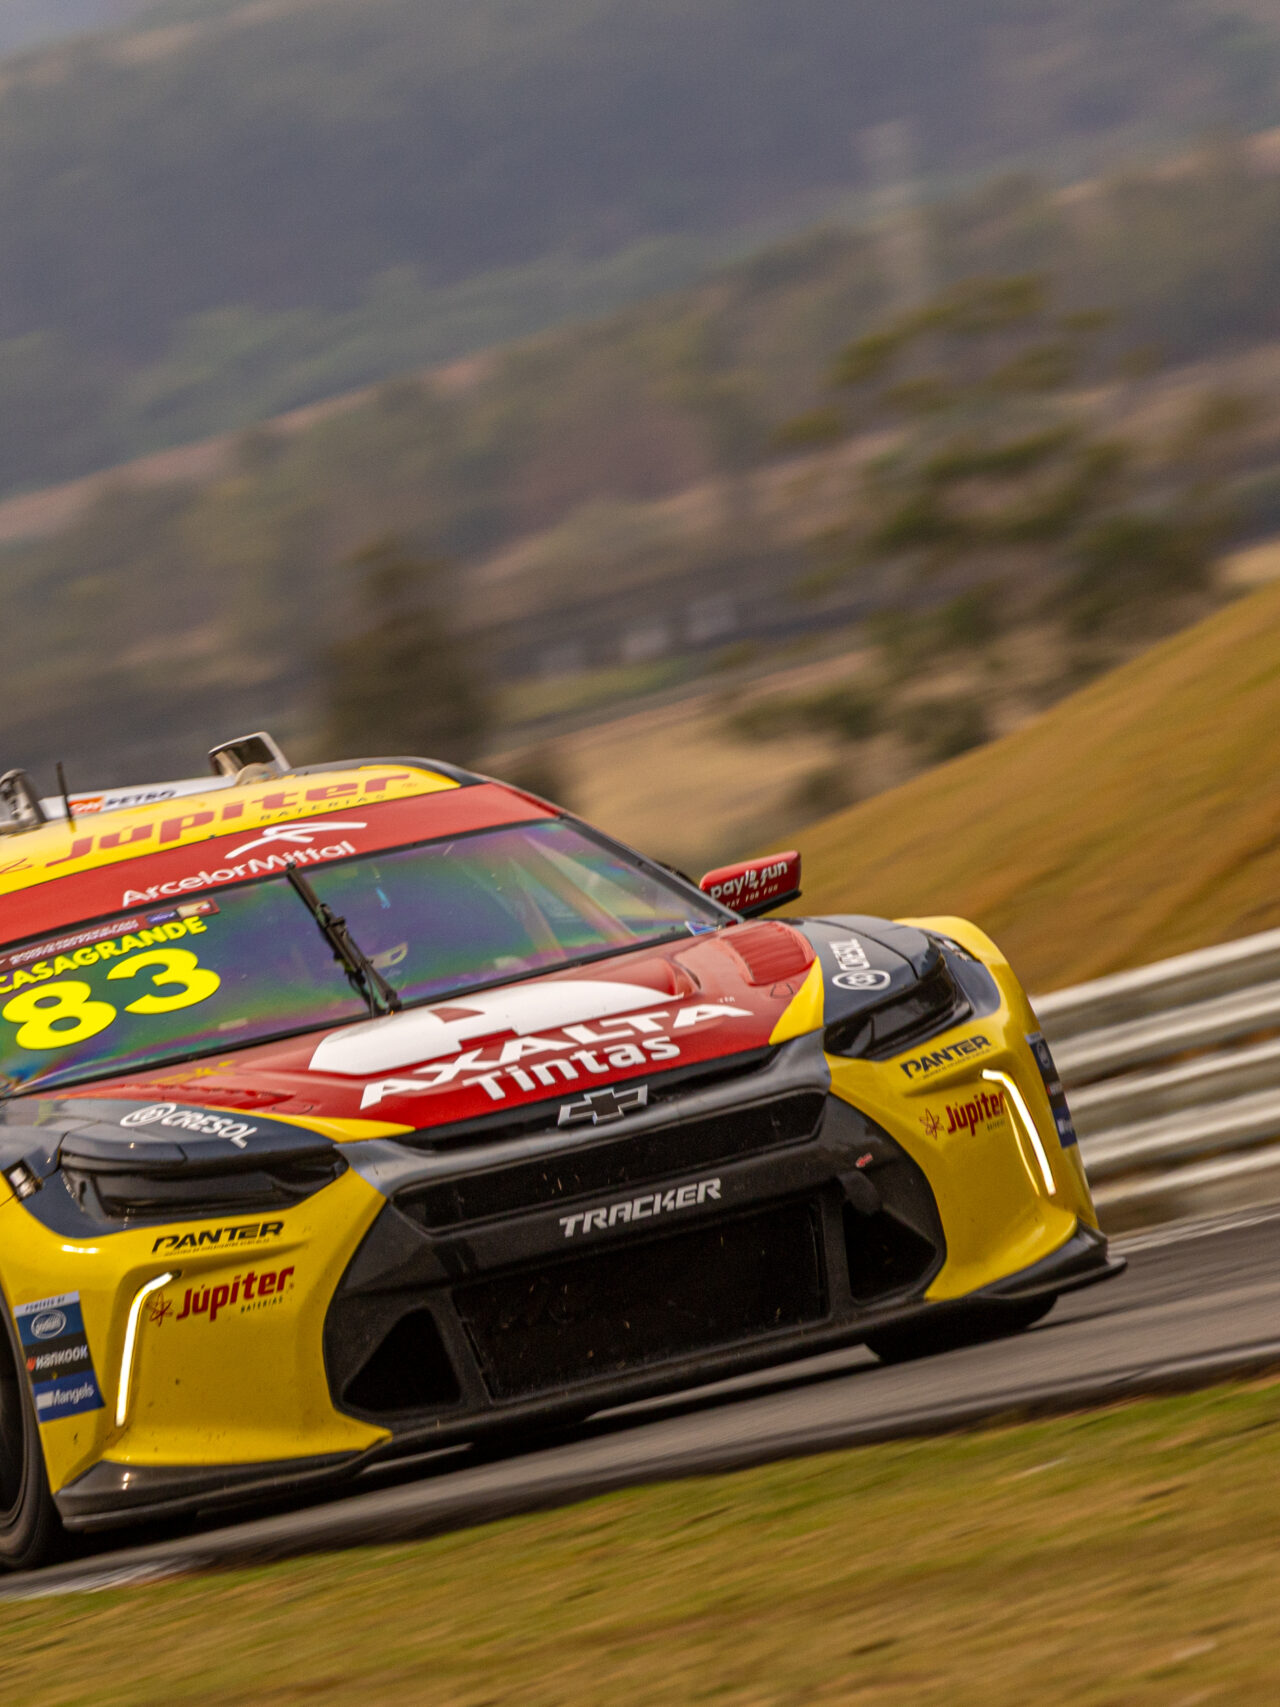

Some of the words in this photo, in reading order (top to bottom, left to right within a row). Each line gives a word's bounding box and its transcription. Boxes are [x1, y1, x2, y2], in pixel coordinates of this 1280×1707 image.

[122, 841, 356, 908] ArcelorMittal
[2, 948, 221, 1050] 83
[360, 1003, 754, 1110] AXALTA
[462, 1036, 681, 1101] Tintas
[900, 1035, 992, 1079] PANTER
[160, 1110, 258, 1150] CRESOL
[152, 1221, 284, 1254] PANTER
[559, 1177, 721, 1238] TRACKER
[176, 1265, 295, 1323] Júpiter
